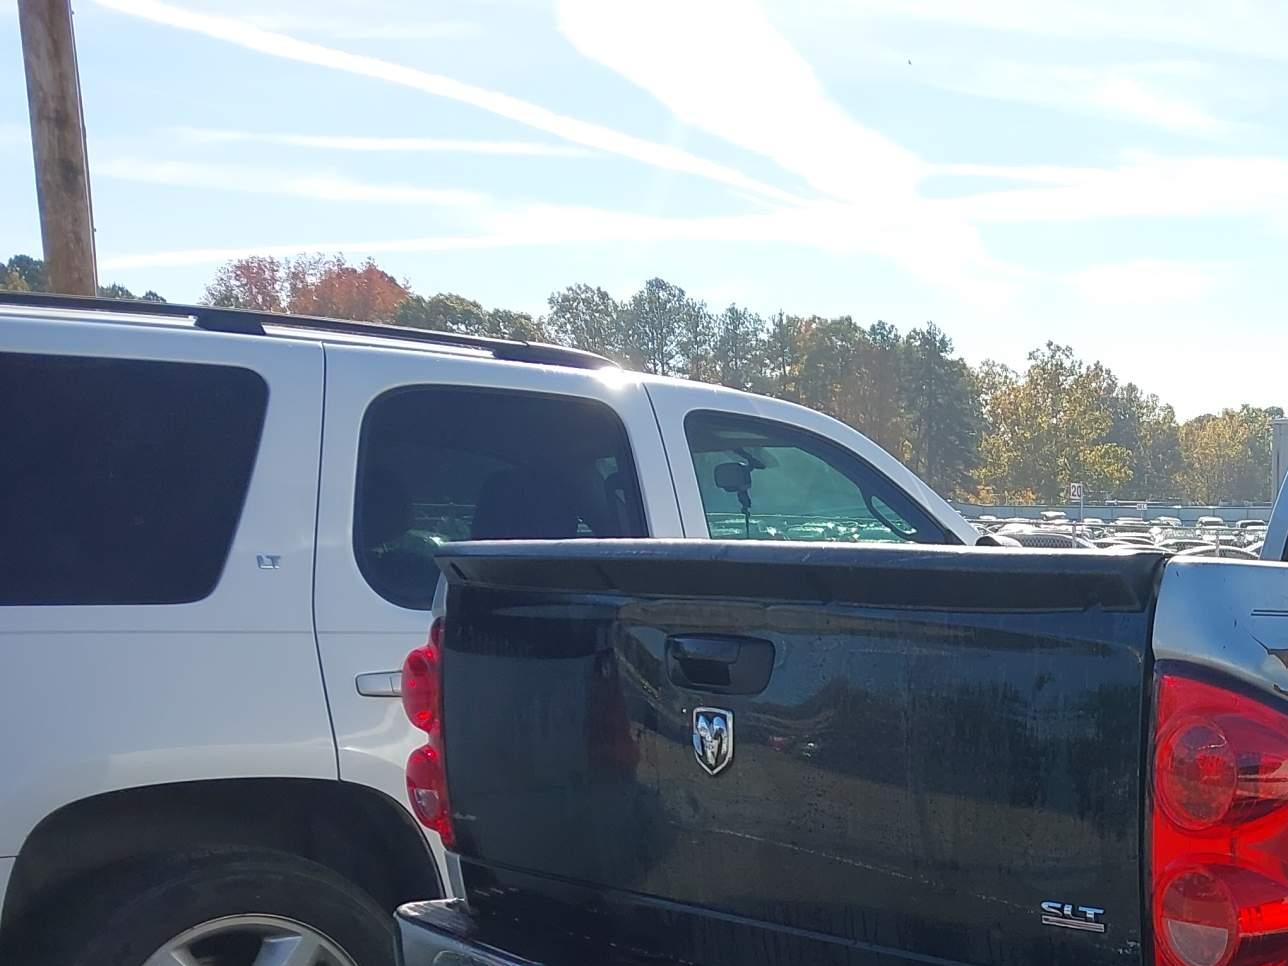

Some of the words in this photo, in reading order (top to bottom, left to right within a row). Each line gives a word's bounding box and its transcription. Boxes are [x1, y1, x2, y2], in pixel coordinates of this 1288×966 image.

[1071, 485, 1082, 497] 20
[256, 555, 281, 569] LT
[1041, 901, 1105, 922] SLT
